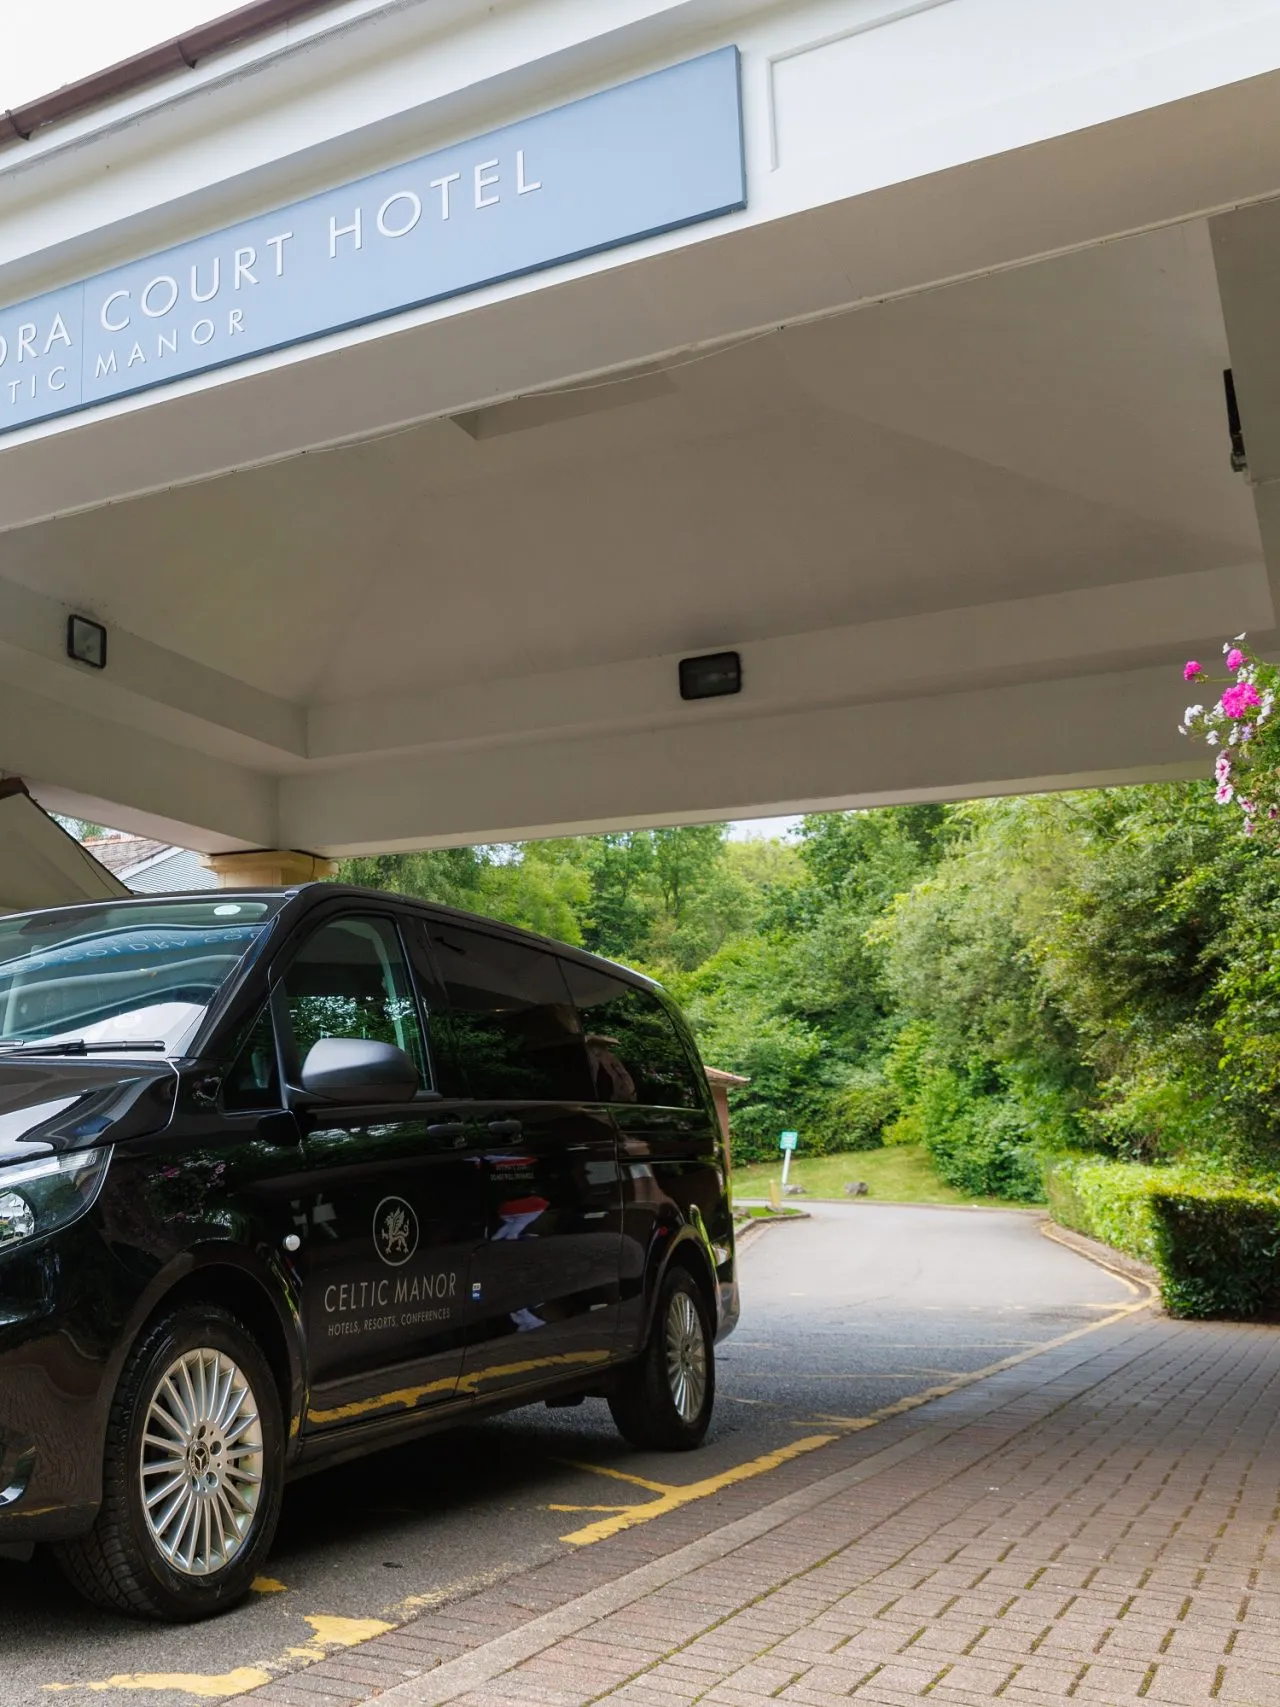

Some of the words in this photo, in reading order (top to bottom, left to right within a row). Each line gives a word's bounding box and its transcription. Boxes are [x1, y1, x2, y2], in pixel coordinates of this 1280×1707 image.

[100, 231, 294, 332] COURT
[328, 150, 542, 259] HOTEL
[95, 308, 245, 378] MANOR
[324, 1279, 389, 1312] CELTIC
[394, 1272, 456, 1303] MANOR
[328, 1320, 361, 1336] HOTELS,
[400, 1307, 451, 1326] CONFERENCES
